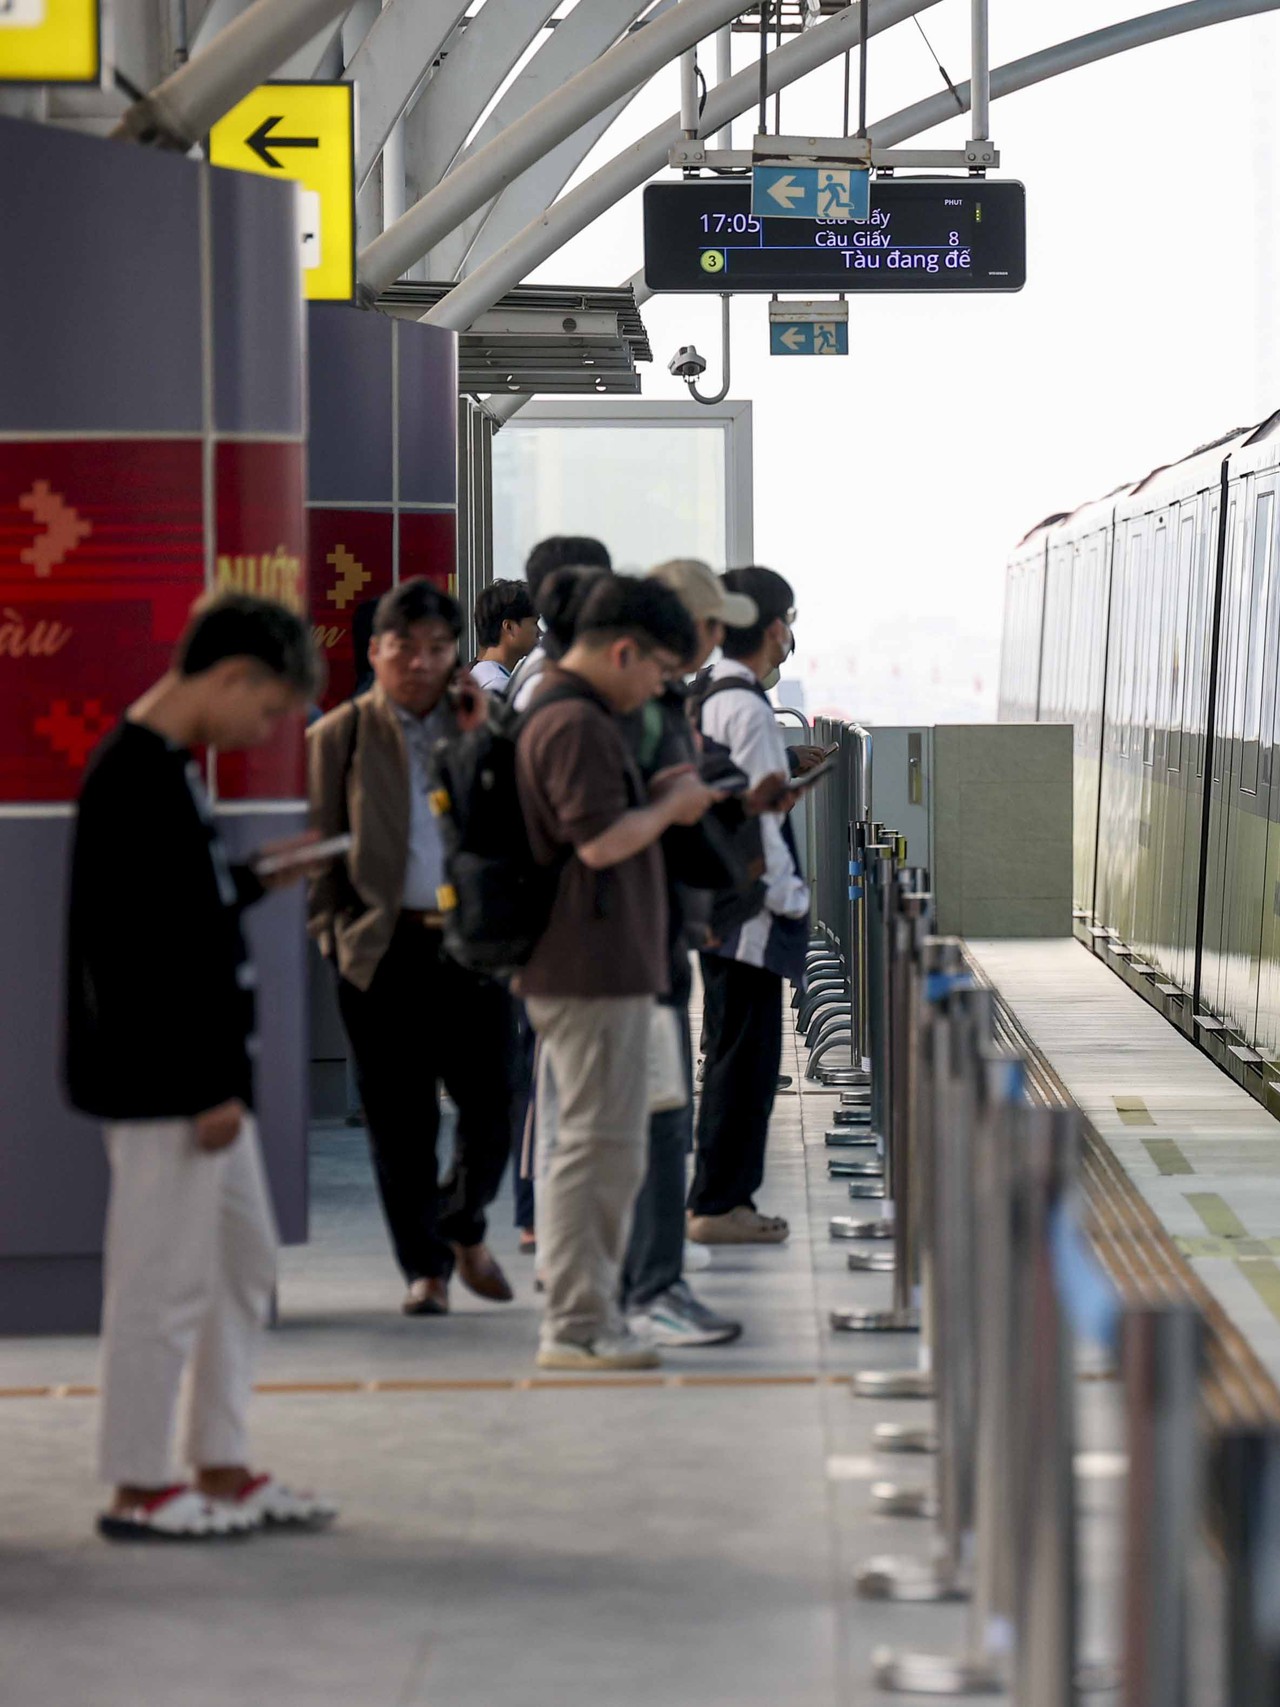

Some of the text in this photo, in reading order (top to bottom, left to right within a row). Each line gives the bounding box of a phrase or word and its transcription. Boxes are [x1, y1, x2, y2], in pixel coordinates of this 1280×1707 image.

[700, 213, 760, 233] 17:05
[815, 230, 959, 248] Cầu Giấy 8
[708, 255, 717, 267] 3
[841, 248, 972, 273] Tàu đang đế
